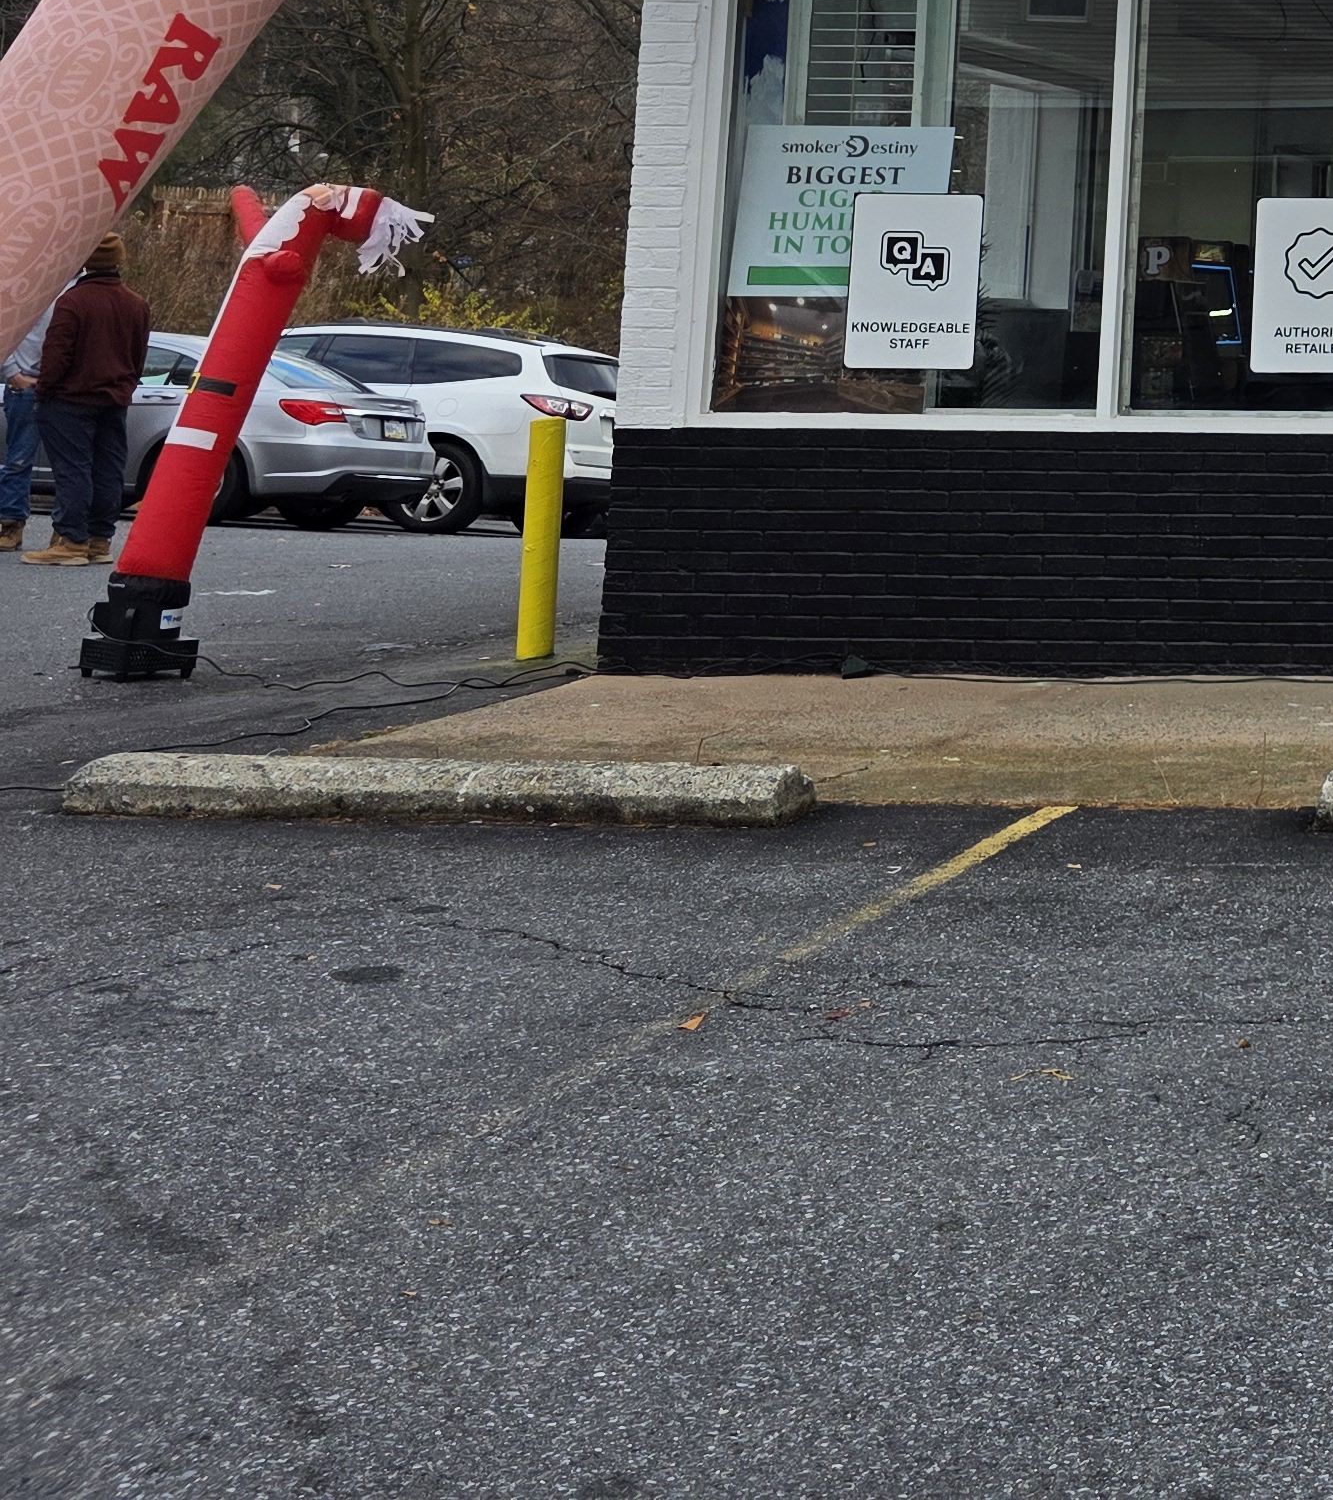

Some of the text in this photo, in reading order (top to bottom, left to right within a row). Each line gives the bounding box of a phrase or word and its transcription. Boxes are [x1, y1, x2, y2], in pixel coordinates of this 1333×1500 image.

[55, 41, 108, 108] RAW
[98, 11, 223, 214] RAW
[786, 165, 906, 186] BIGGEST
[798, 188, 858, 208] CIG
[768, 211, 852, 231] HUMI
[773, 235, 850, 254] IN TO
[892, 241, 911, 261] Q
[920, 257, 936, 276] A
[851, 321, 971, 335] KNOWLEDGEABLE
[889, 338, 930, 350] STAFF
